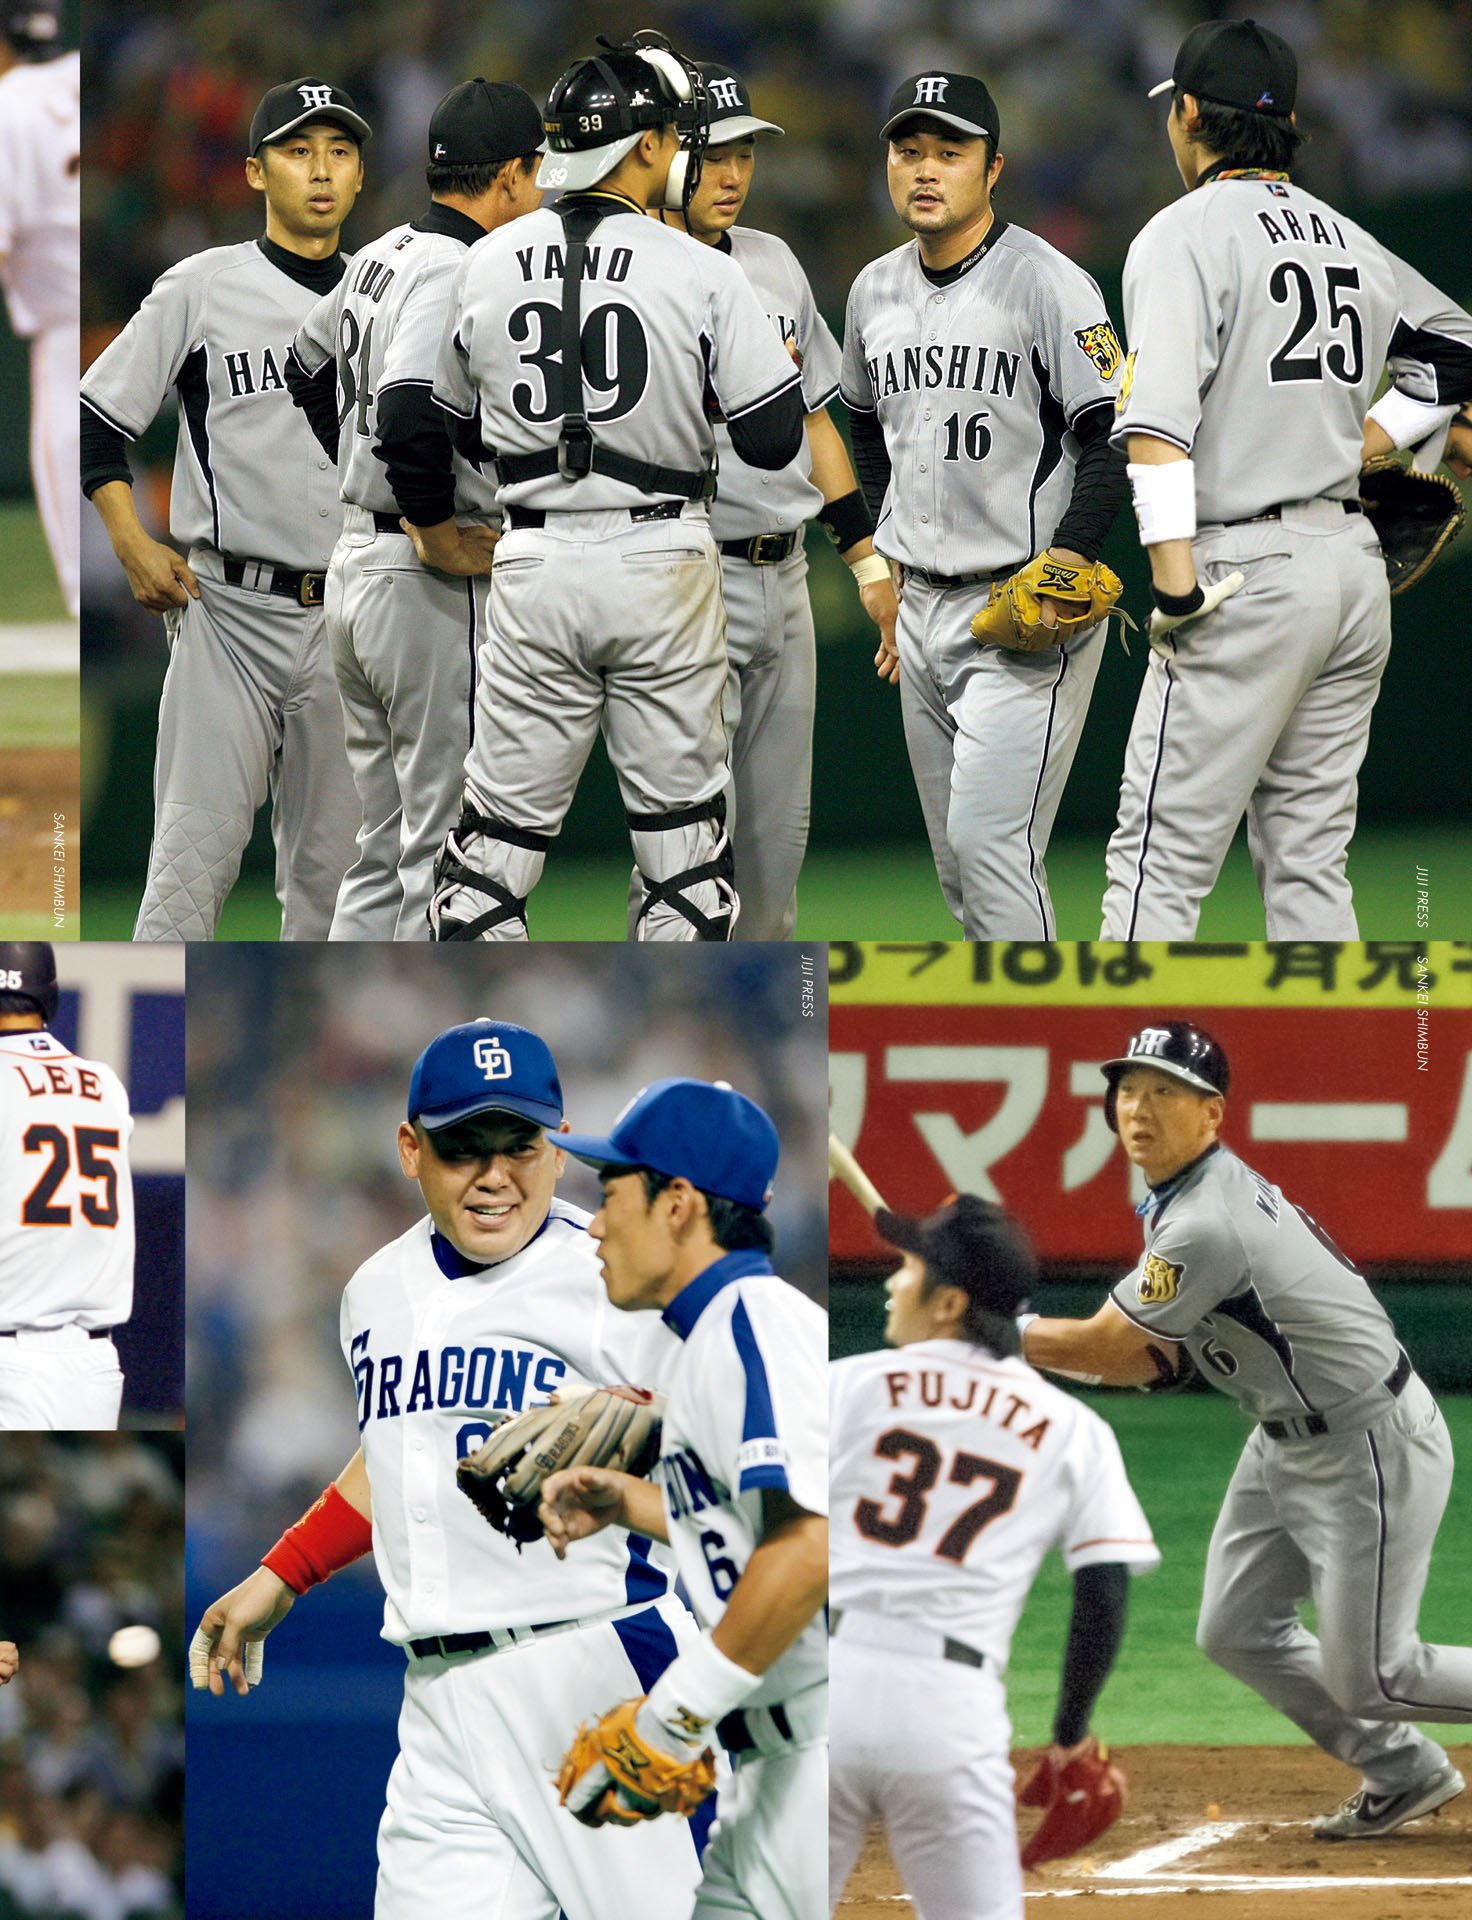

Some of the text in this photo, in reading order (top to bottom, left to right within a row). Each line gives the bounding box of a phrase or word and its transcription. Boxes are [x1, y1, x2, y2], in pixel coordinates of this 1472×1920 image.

[578, 114, 603, 133] 39
[545, 167, 568, 186] 39
[1257, 208, 1347, 250] ARAI
[514, 243, 635, 283] YANO
[1269, 260, 1363, 386] 25
[223, 346, 295, 397] HA
[506, 300, 651, 425] 39
[867, 345, 1022, 401] HANSHIN
[943, 412, 992, 462] 16
[14, 1065, 104, 1103] LEE
[20, 1123, 120, 1230] 25
[1201, 1337, 1239, 1378] 6
[884, 1369, 1052, 1452] FUJITA
[853, 1425, 1025, 1566] 37
[701, 1530, 742, 1602] 6
